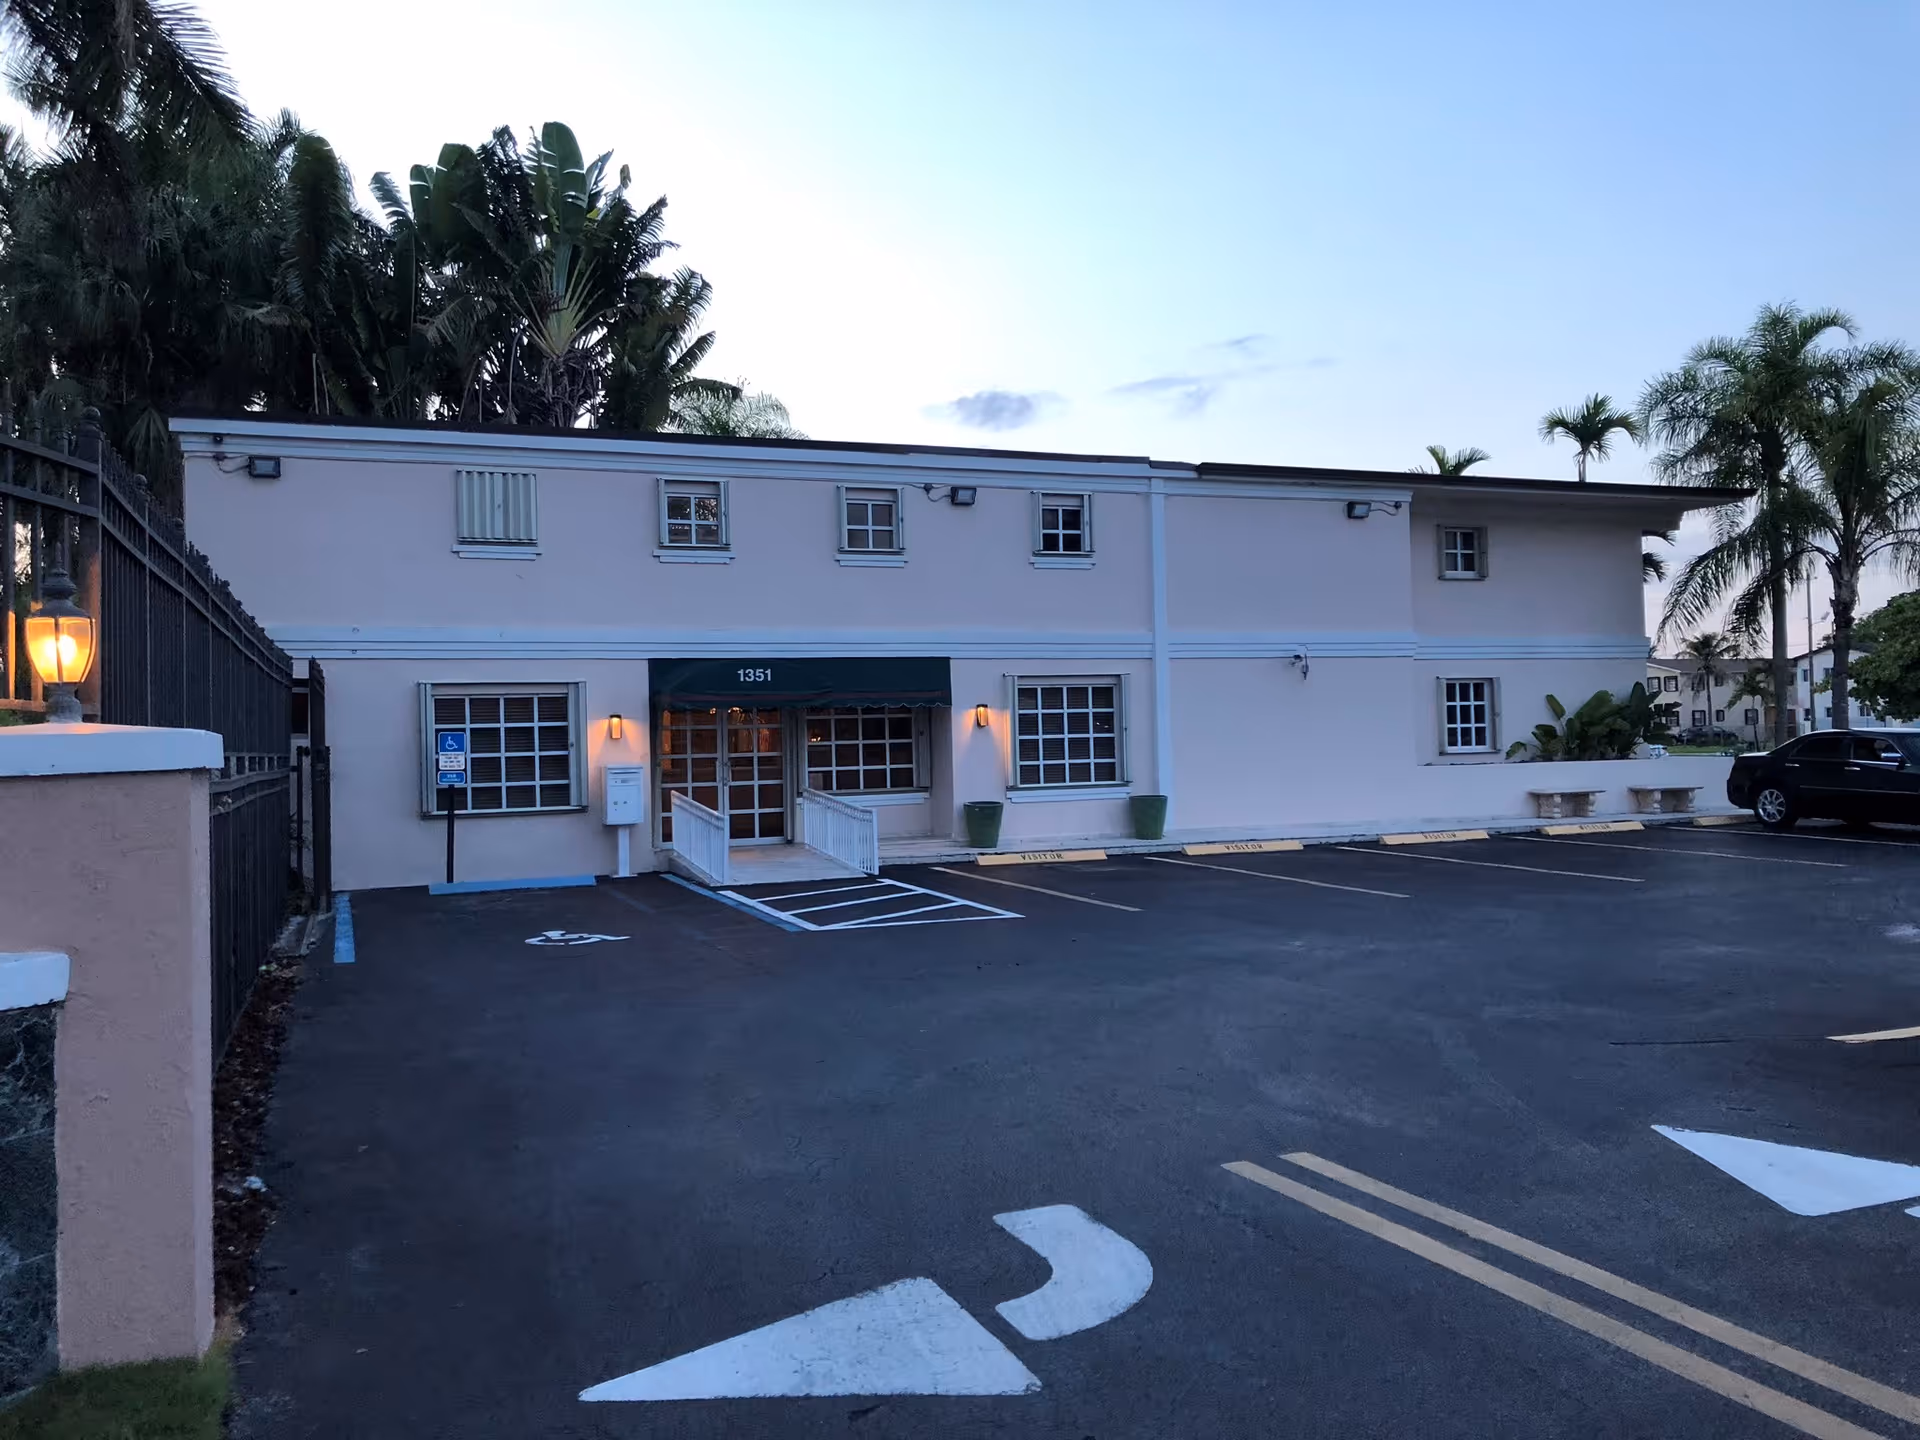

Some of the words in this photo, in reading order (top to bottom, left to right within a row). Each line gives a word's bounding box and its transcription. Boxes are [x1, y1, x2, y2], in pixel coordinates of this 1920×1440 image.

[737, 668, 772, 682] 1351
[1223, 843, 1264, 851] VISITOR
[1019, 852, 1064, 861] VISITOR
